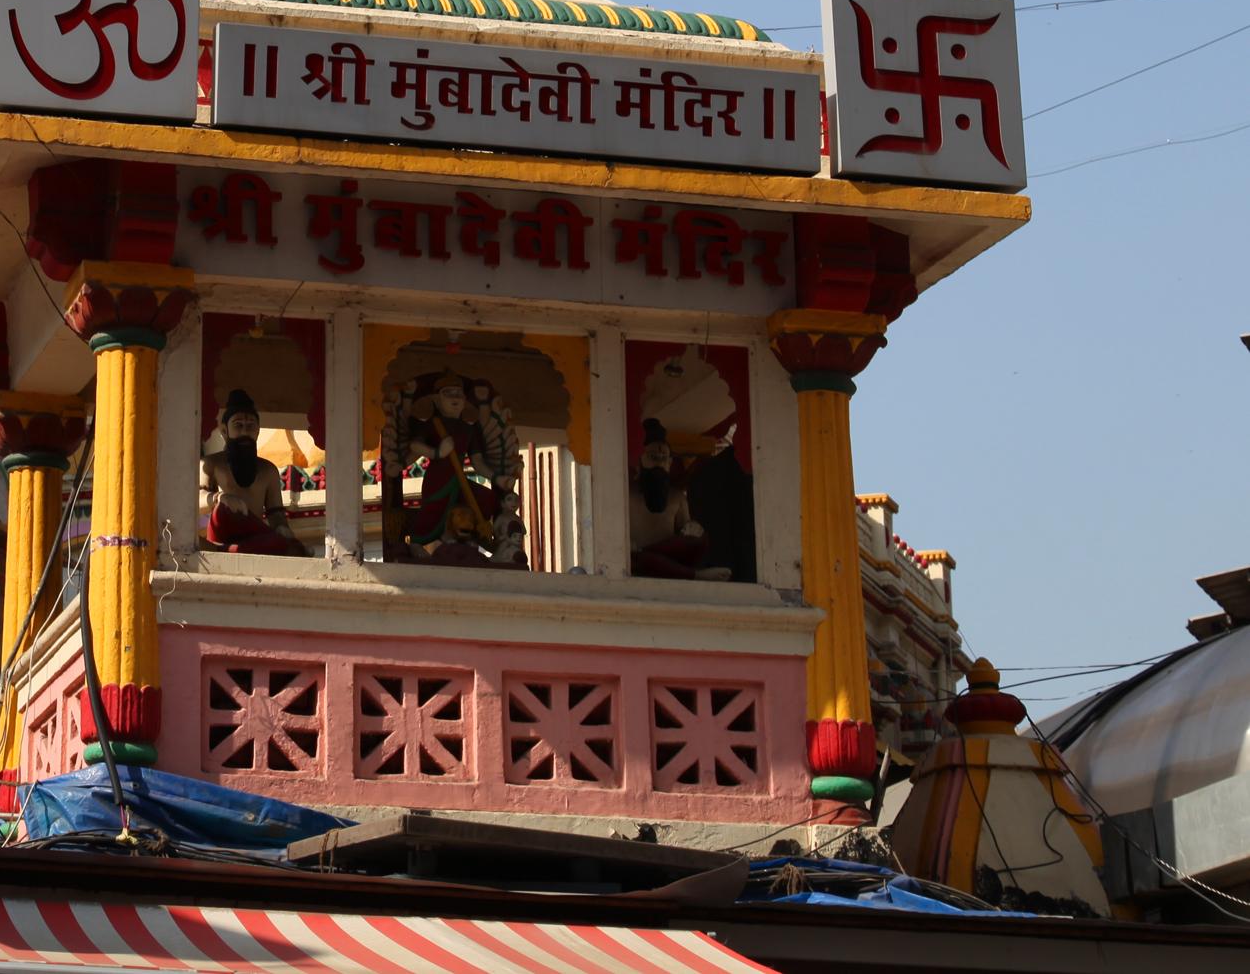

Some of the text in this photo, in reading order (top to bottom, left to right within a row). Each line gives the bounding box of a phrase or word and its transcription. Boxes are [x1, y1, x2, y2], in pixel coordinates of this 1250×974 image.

[301, 42, 374, 105] श्री
[389, 48, 599, 131] मुंबादेवी
[614, 68, 744, 137] मंदिर
[188, 173, 789, 287] श्री मुंबादेवी मंदिर
